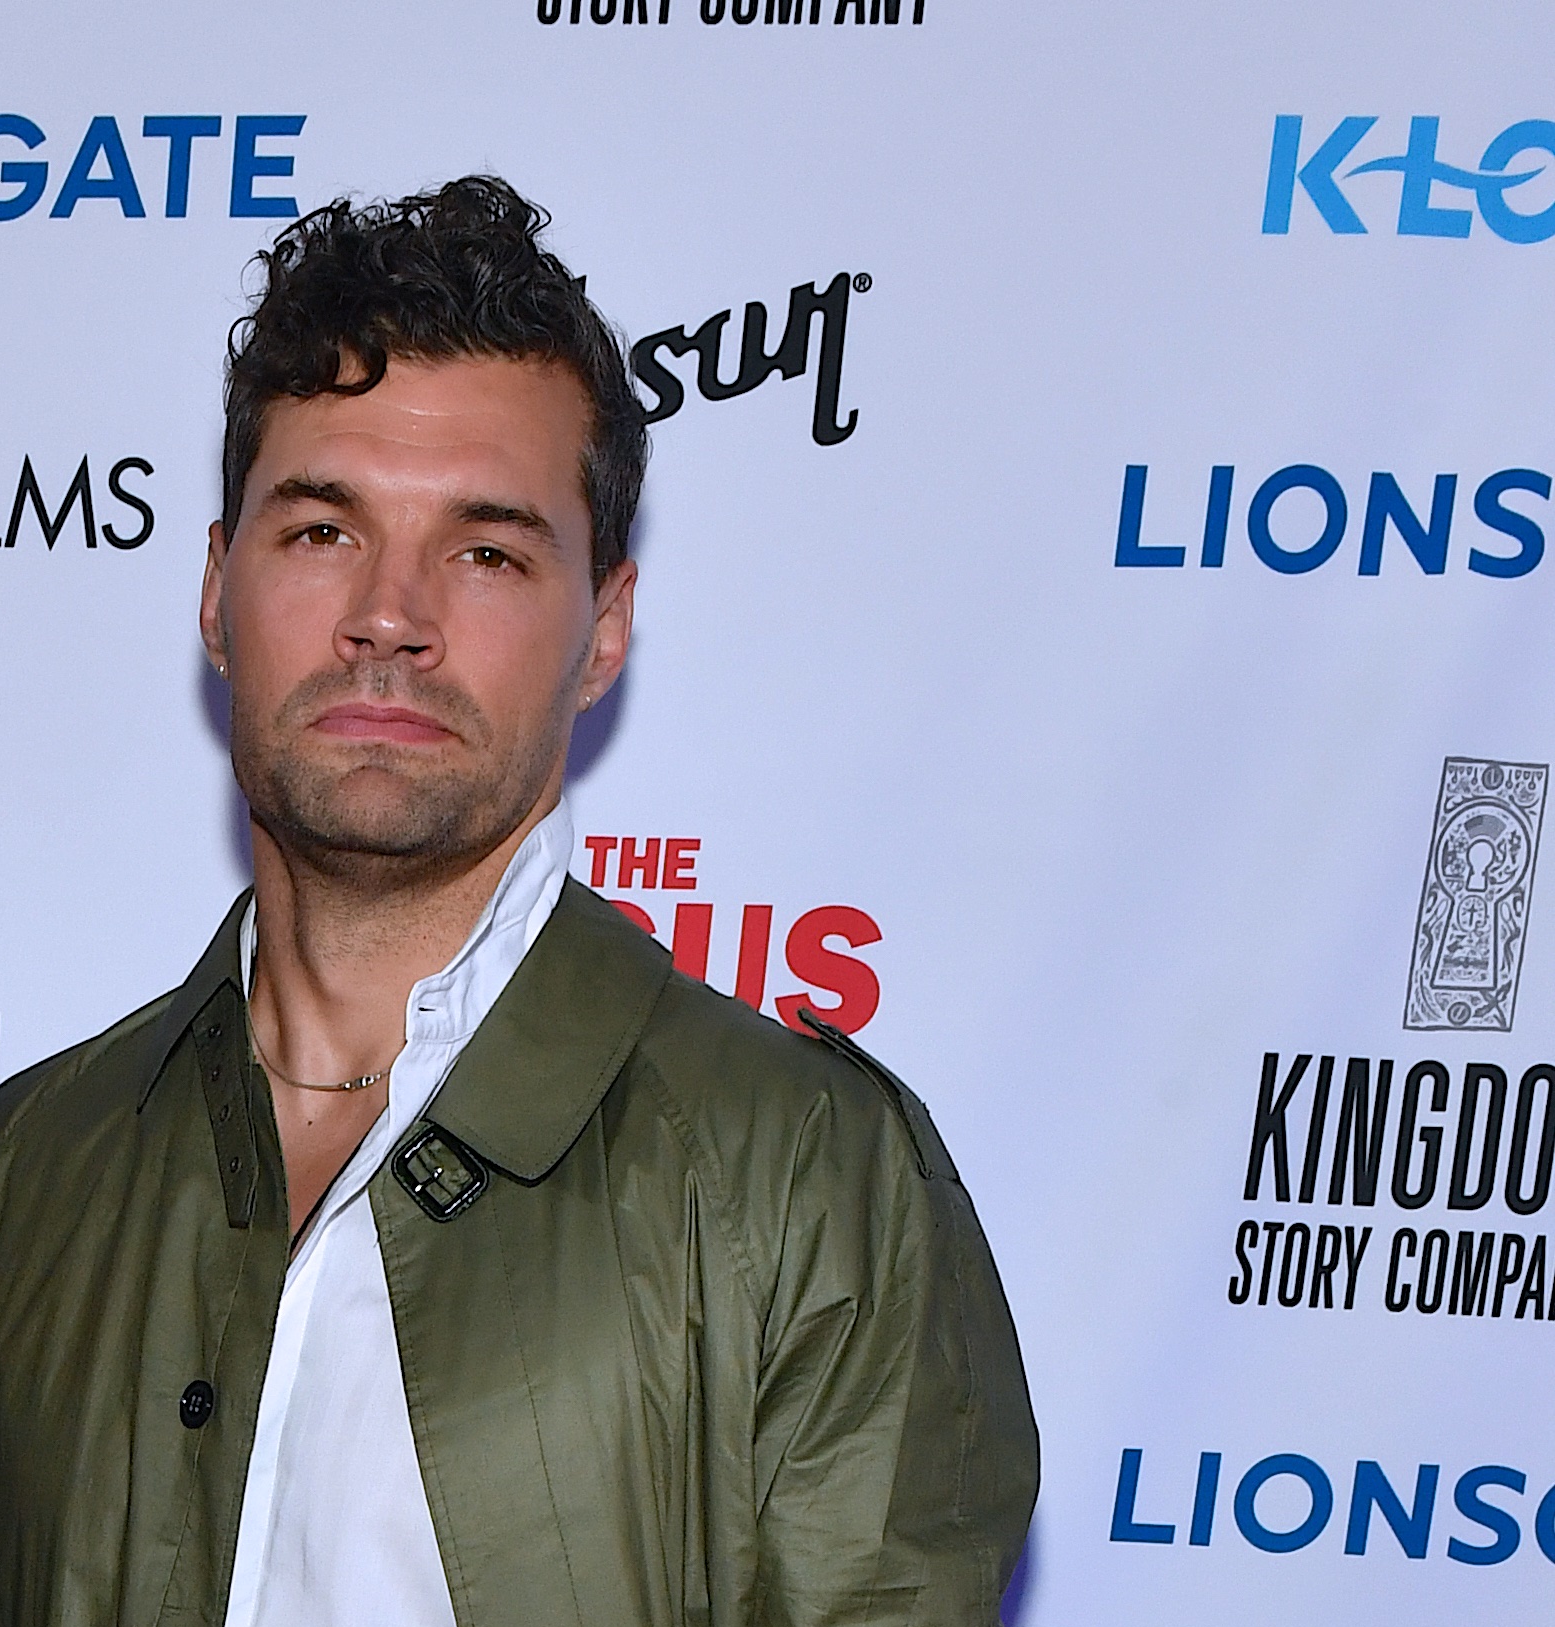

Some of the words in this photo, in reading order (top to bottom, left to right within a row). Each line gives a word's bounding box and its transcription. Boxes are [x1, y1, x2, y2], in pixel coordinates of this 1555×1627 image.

[1115, 464, 1553, 578] LIONS
[585, 836, 701, 889] THE
[606, 900, 883, 1040] US
[1228, 1219, 1372, 1310] STORY
[1385, 1227, 1555, 1321] COMPA
